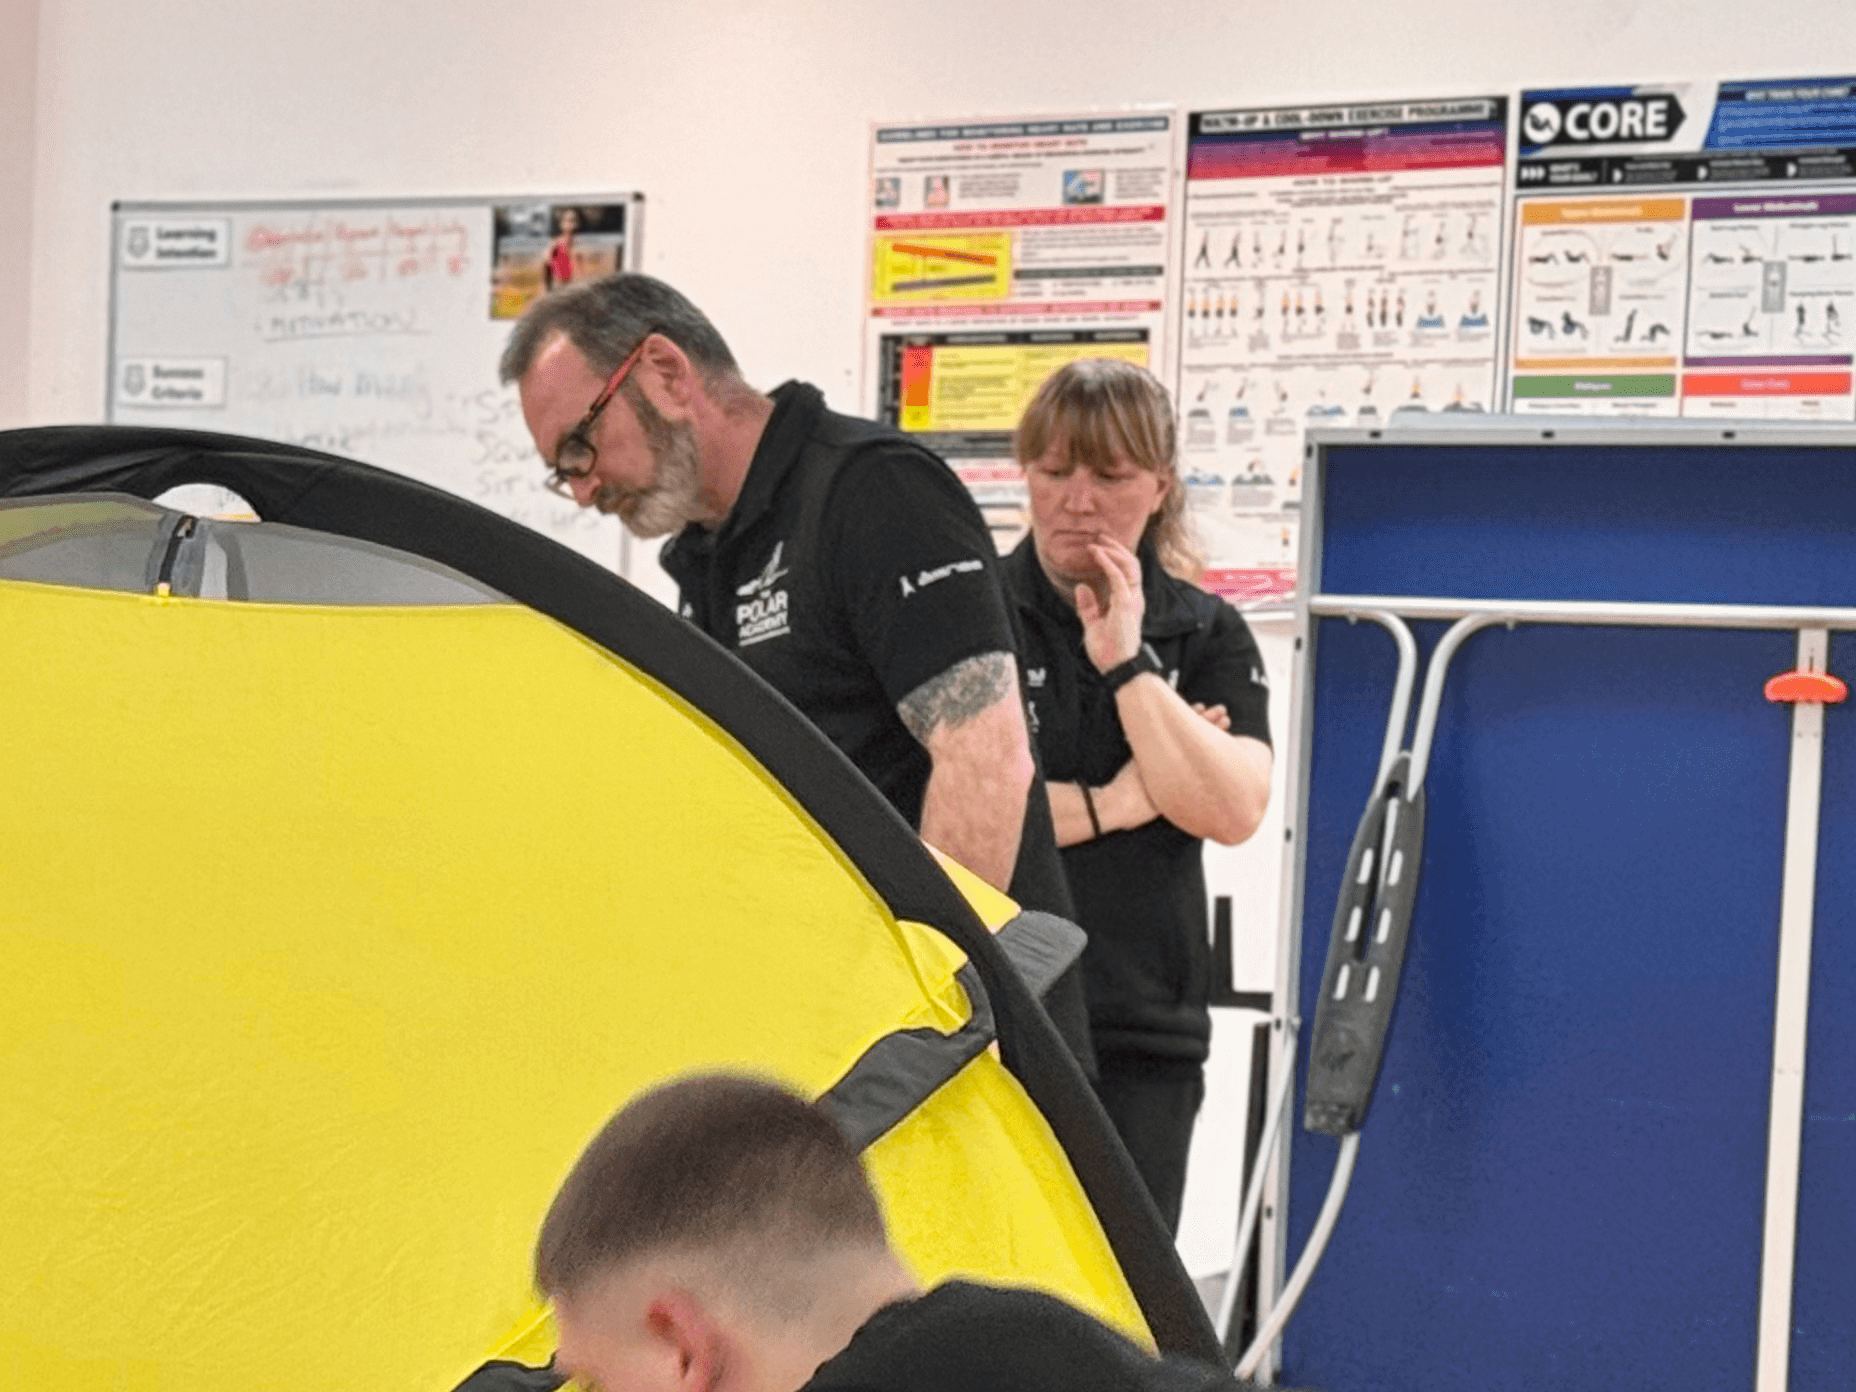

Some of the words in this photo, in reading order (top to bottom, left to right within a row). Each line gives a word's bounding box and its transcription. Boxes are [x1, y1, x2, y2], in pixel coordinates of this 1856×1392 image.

[1564, 100, 1669, 140] CORE
[155, 226, 217, 244] Learning
[155, 246, 217, 260] Intention
[152, 365, 204, 380] Success
[151, 385, 203, 401] Criteria
[736, 589, 789, 625] POLAR
